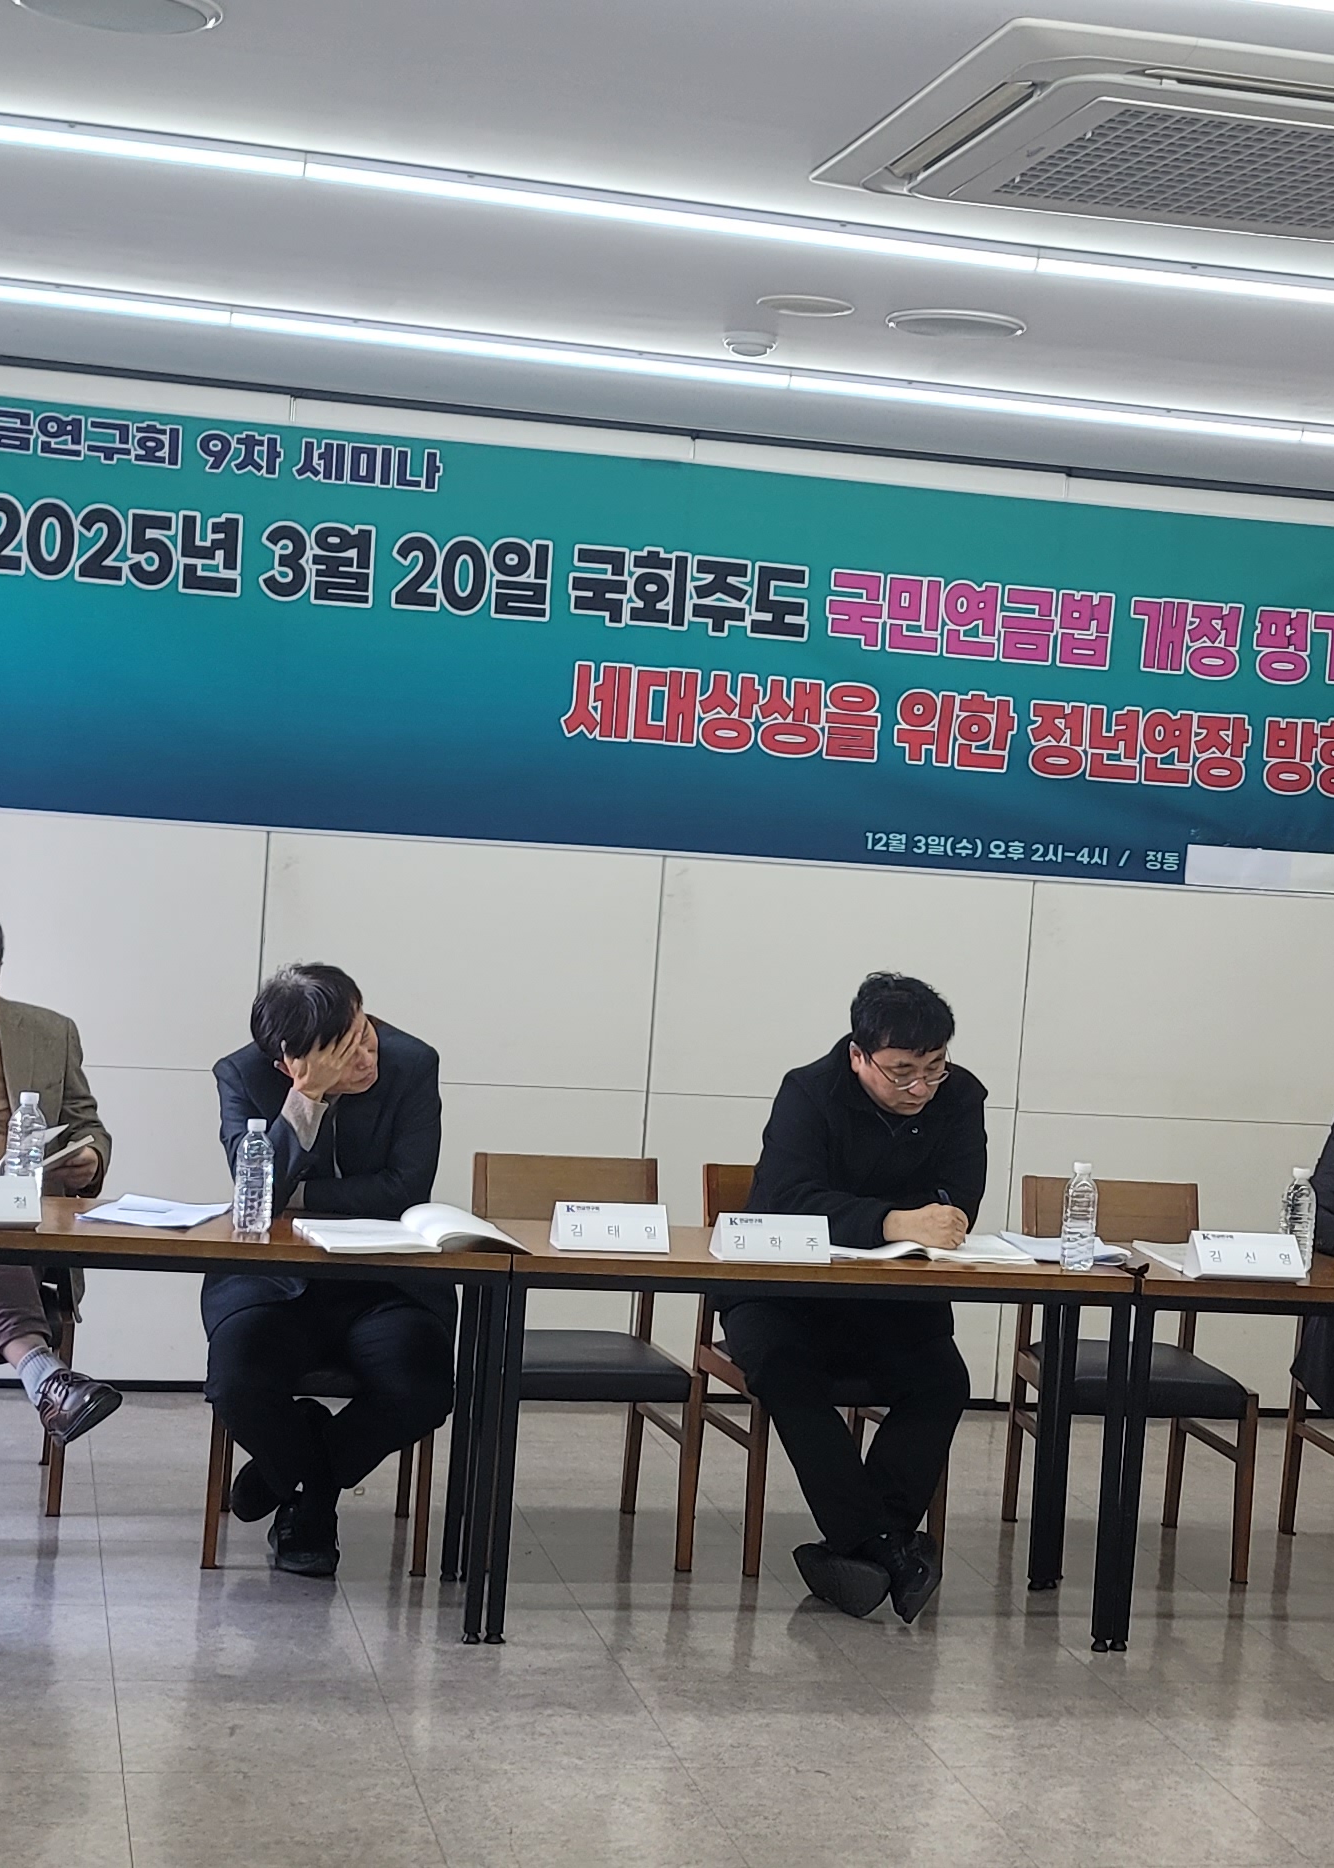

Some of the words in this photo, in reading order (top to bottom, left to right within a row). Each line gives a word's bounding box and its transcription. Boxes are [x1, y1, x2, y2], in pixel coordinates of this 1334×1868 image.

[197, 431, 282, 478] 9차
[294, 438, 442, 491] 세미나
[260, 521, 375, 608] 3월
[391, 532, 553, 621] 20일
[569, 544, 809, 642] 국회주도
[827, 568, 1115, 670] 국민연금법
[1131, 597, 1244, 679] 개정
[561, 661, 879, 763] 세대상생을
[894, 690, 1017, 773] 위한
[1027, 700, 1252, 788] 정년연장
[865, 832, 907, 853] 12월
[912, 835, 982, 858] 3일(수)
[988, 839, 1025, 861] 오후
[1031, 843, 1108, 866] 2시-4시
[1145, 850, 1180, 871] 정동
